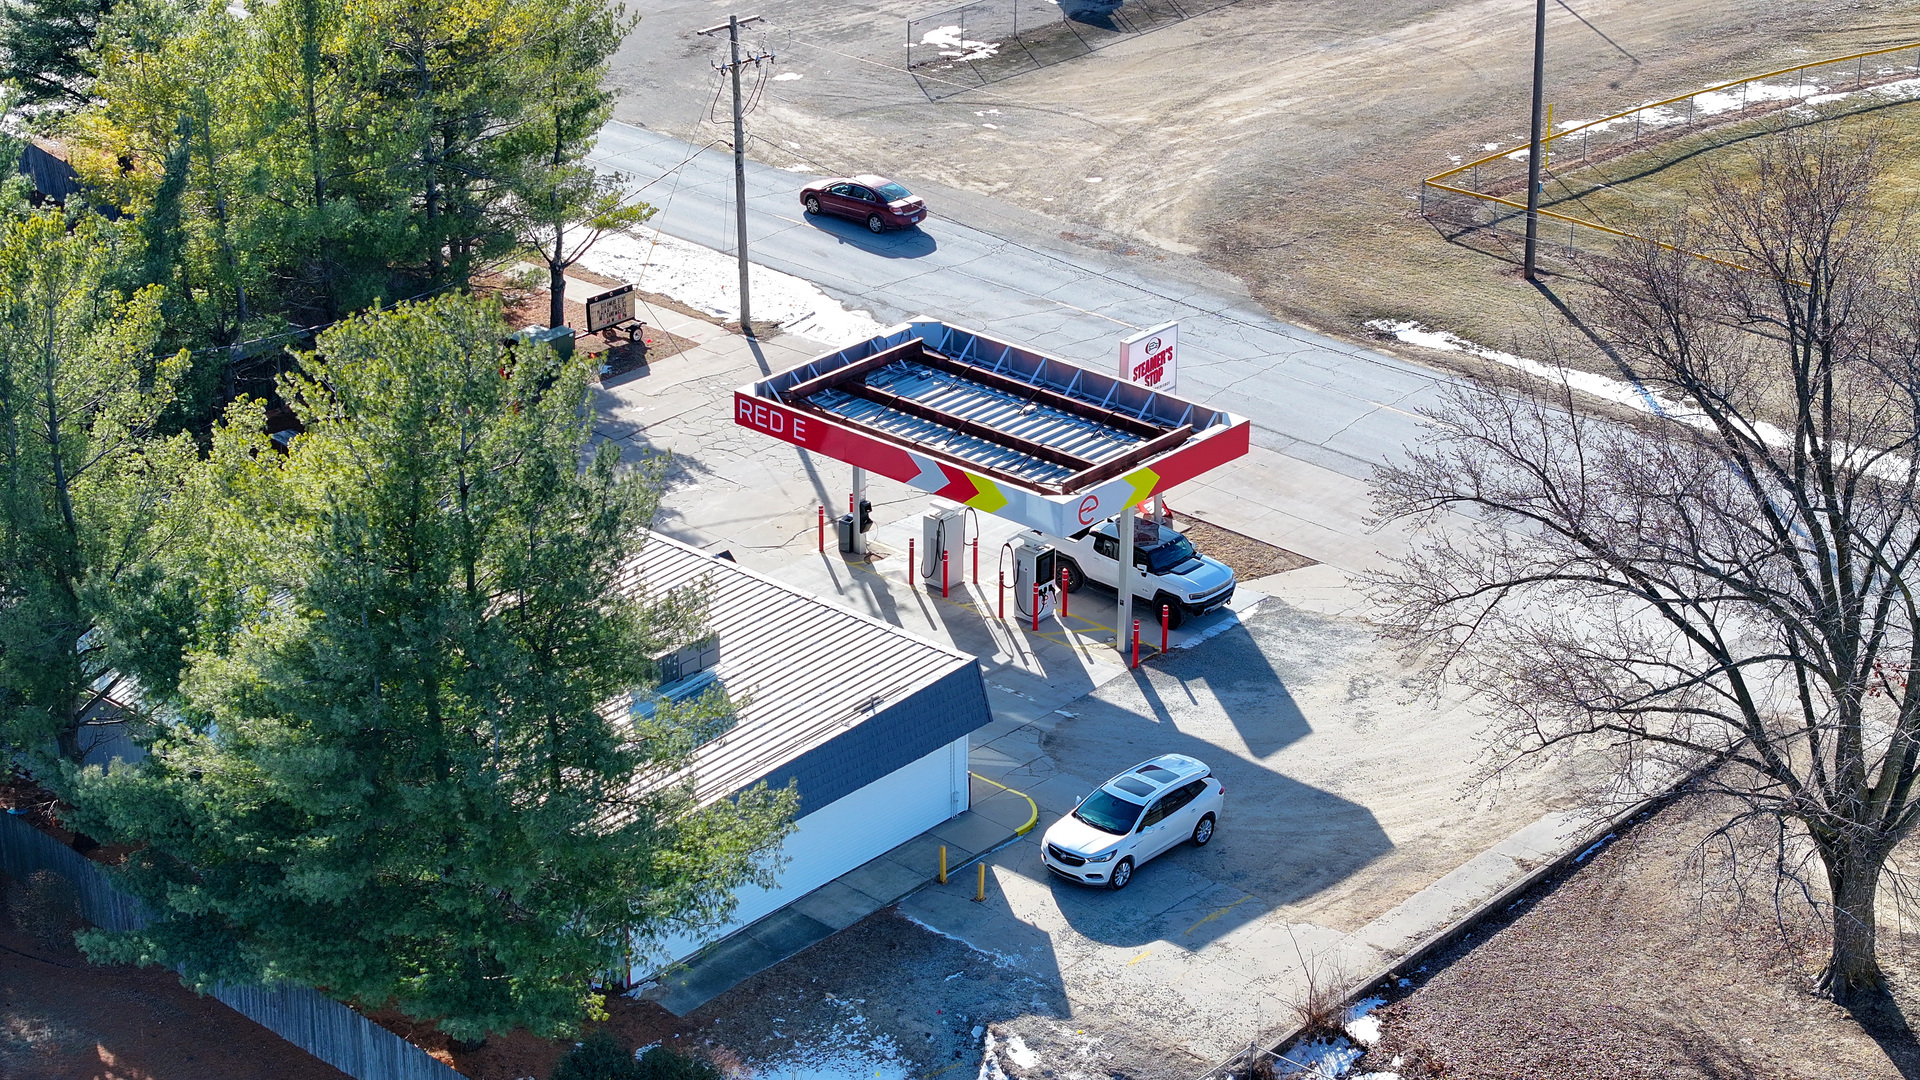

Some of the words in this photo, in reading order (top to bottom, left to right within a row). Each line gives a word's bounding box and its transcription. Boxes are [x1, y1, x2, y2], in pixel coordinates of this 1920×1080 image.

[1133, 346, 1173, 382] STEAMER'S
[1145, 366, 1163, 386] STOP
[739, 399, 784, 433] RED
[793, 417, 806, 442] E
